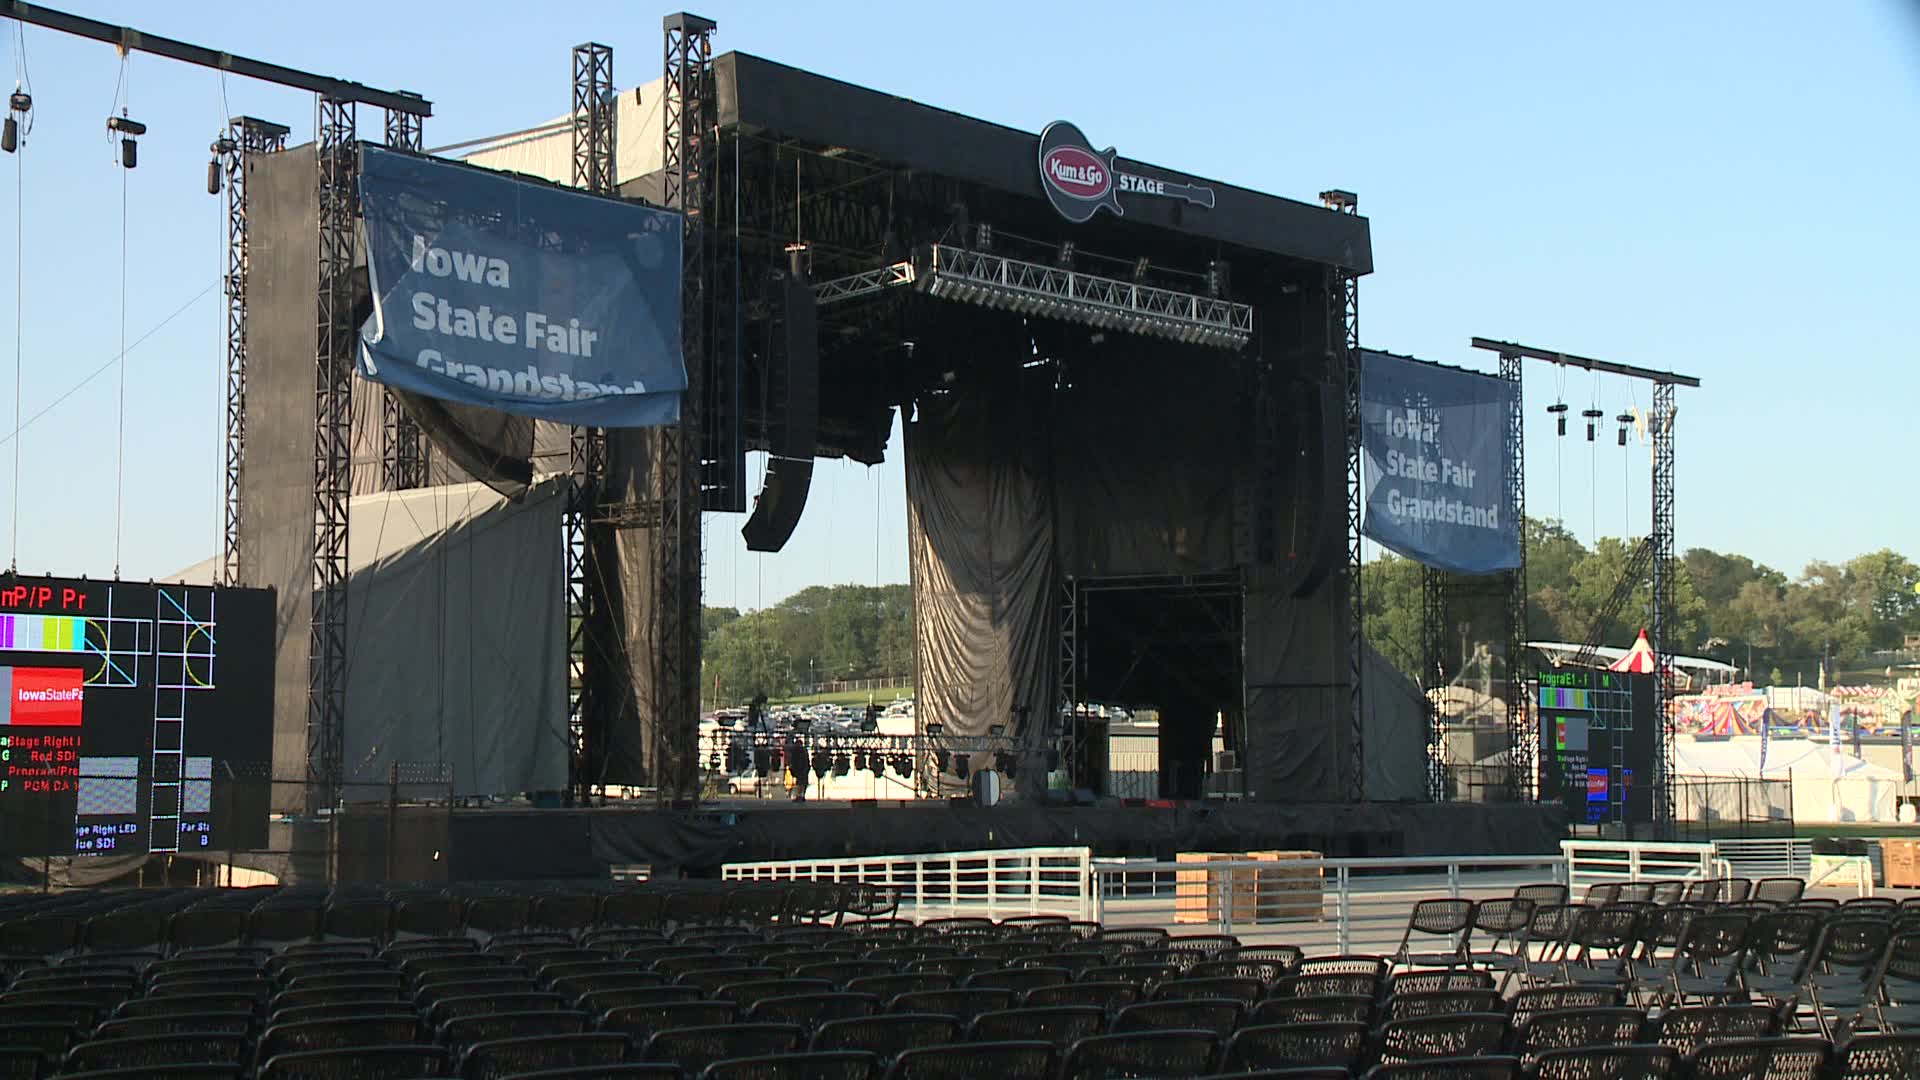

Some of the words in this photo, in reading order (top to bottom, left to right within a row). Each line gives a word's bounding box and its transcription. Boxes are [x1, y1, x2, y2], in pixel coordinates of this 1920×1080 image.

[1119, 175, 1164, 195] STAGE
[412, 234, 511, 289] Iowa
[411, 291, 519, 345] State
[525, 311, 598, 357] Fair
[1385, 408, 1436, 444] Iowa
[1386, 449, 1439, 482] State
[1441, 457, 1477, 489] Fair
[1386, 488, 1499, 529] Grandstand
[8, 735, 40, 749] Stage
[43, 735, 74, 749] Right
[31, 751, 53, 762] Red
[56, 751, 77, 762] SDI
[92, 824, 118, 836] Right
[118, 824, 137, 834] LED
[95, 838, 116, 849] SDI
